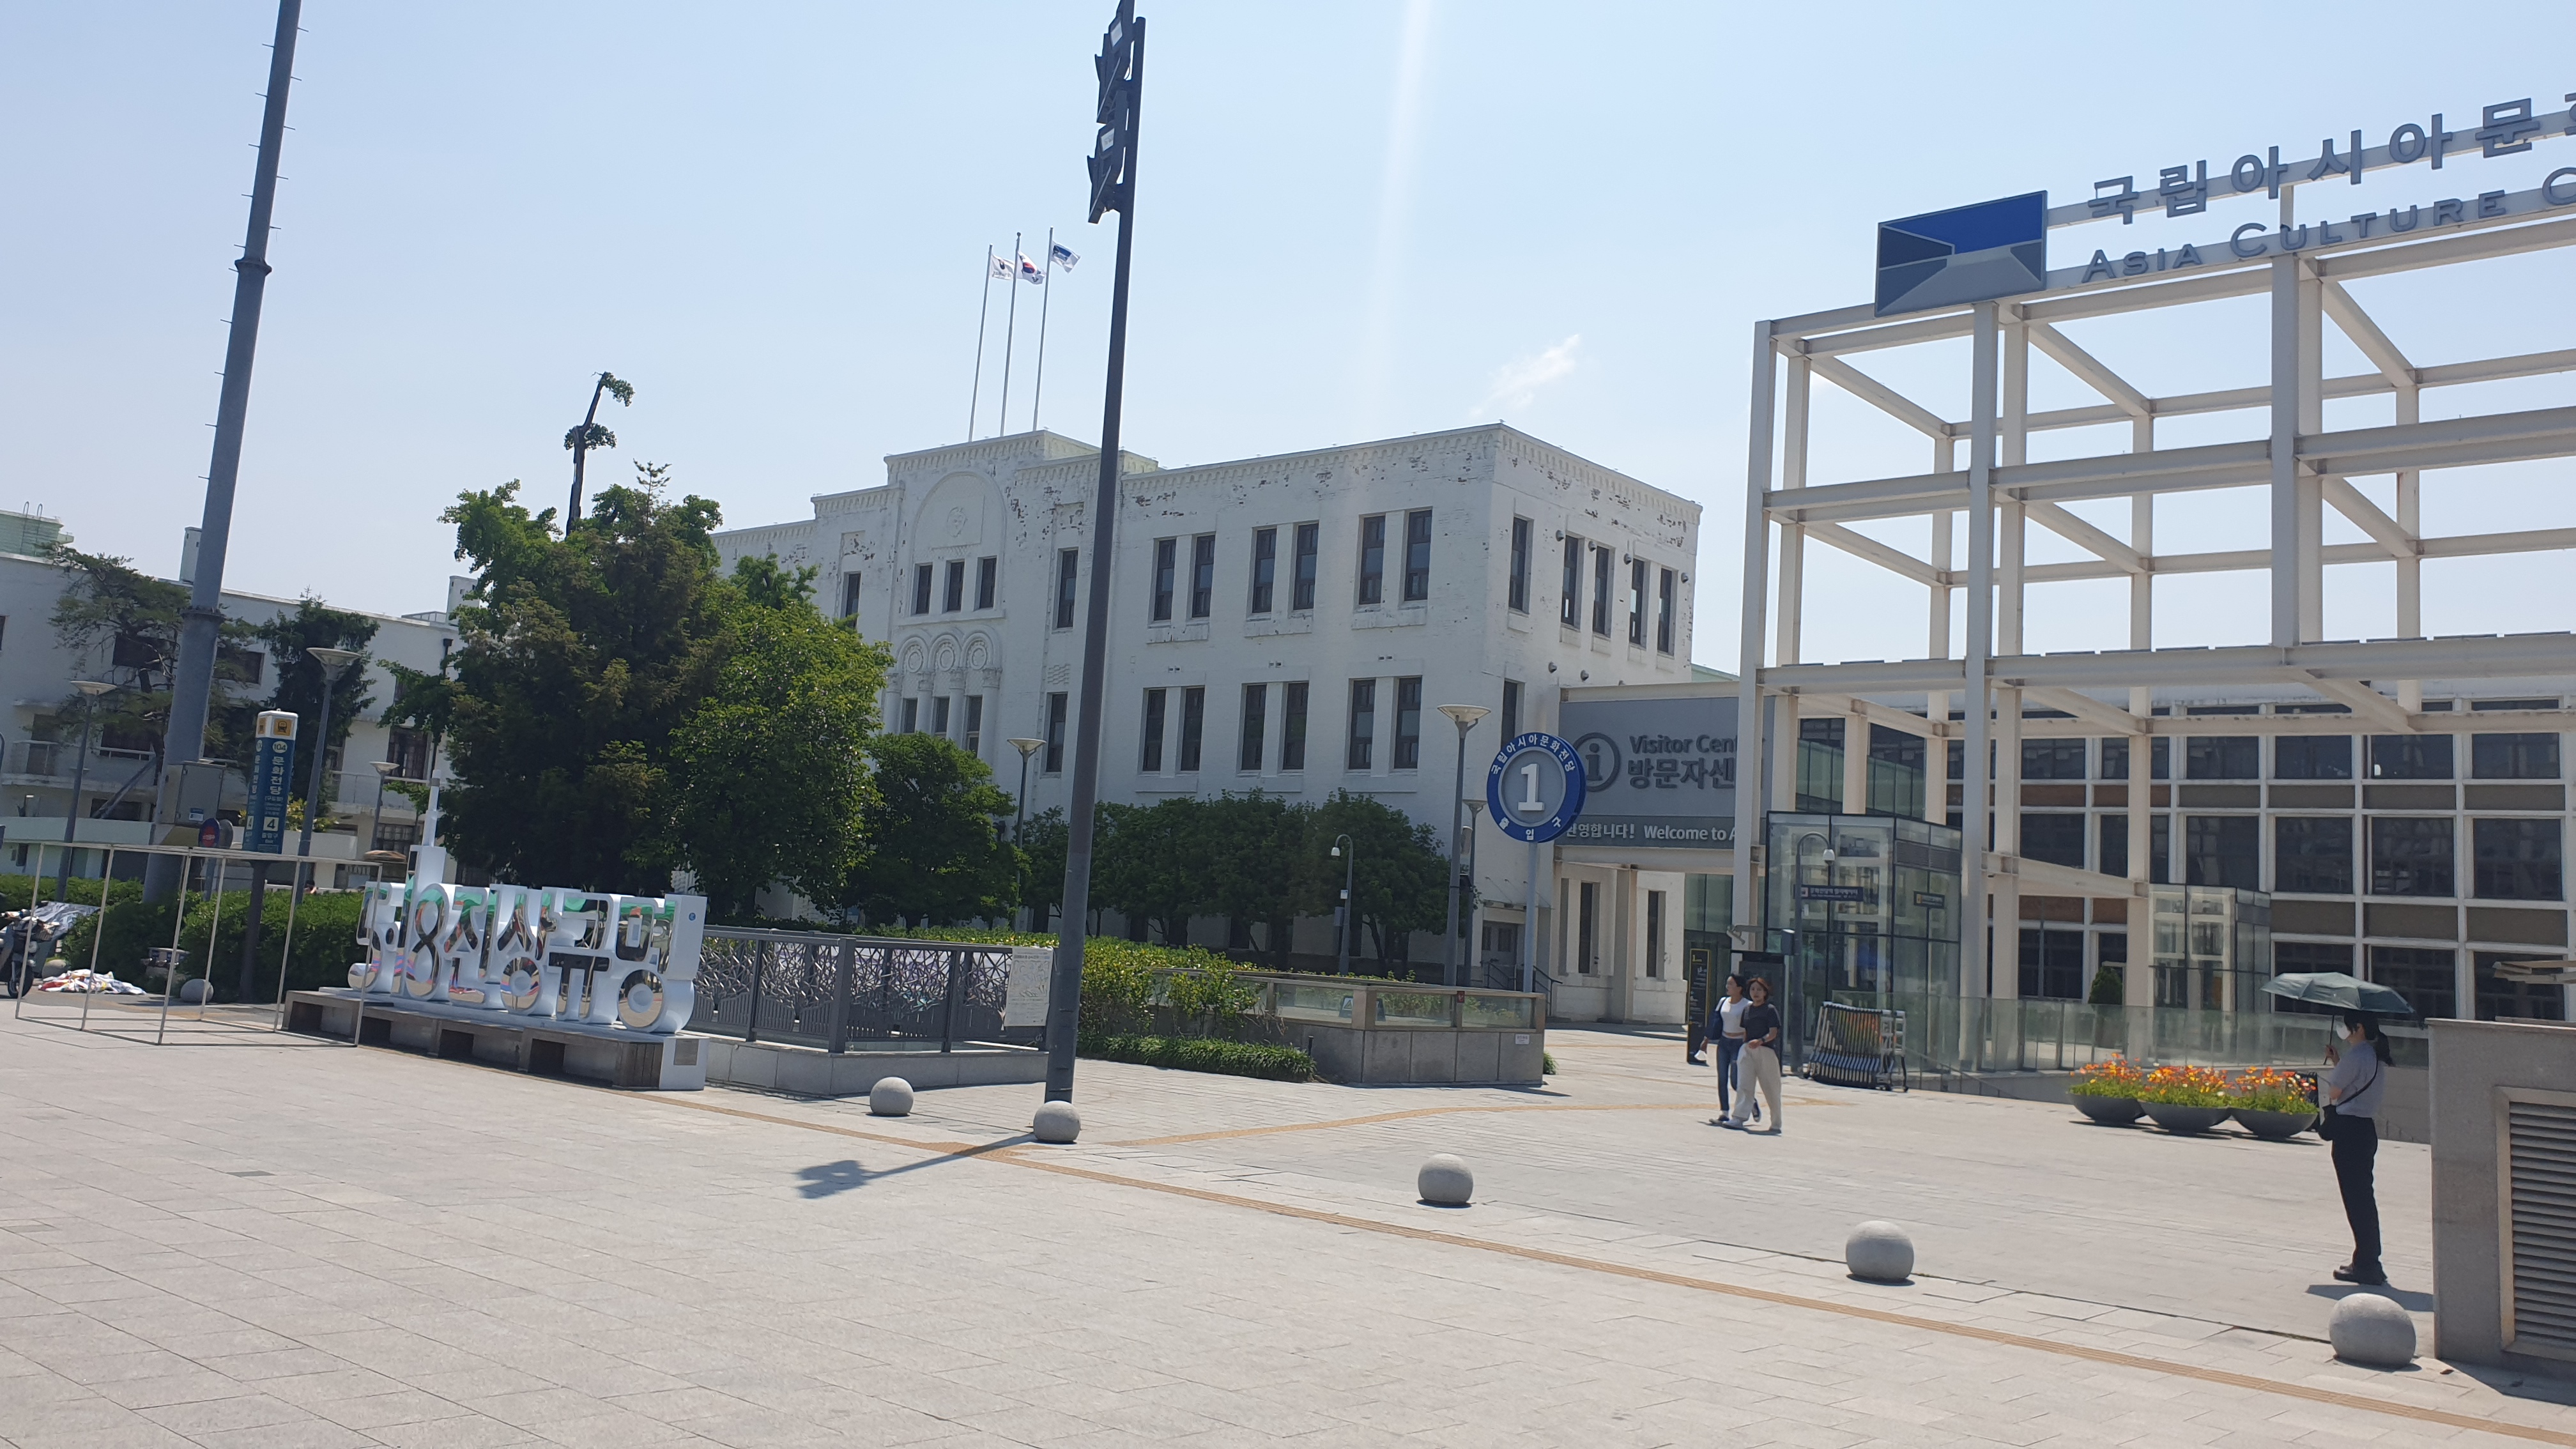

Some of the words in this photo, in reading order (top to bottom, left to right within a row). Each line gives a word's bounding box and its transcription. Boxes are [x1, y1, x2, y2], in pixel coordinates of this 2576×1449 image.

[2088, 92, 2576, 226] 국립아시아문
[1491, 733, 1575, 775] 국립아시아문화전당
[1629, 735, 1693, 754] Visitor
[270, 756, 285, 795] 문화전당
[1517, 763, 1544, 811] 1
[1627, 757, 1736, 790] 방문자센
[266, 818, 275, 829] 4
[1499, 816, 1561, 841] 출입구
[1643, 824, 1708, 840] Welcome
[1711, 827, 1727, 841] to
